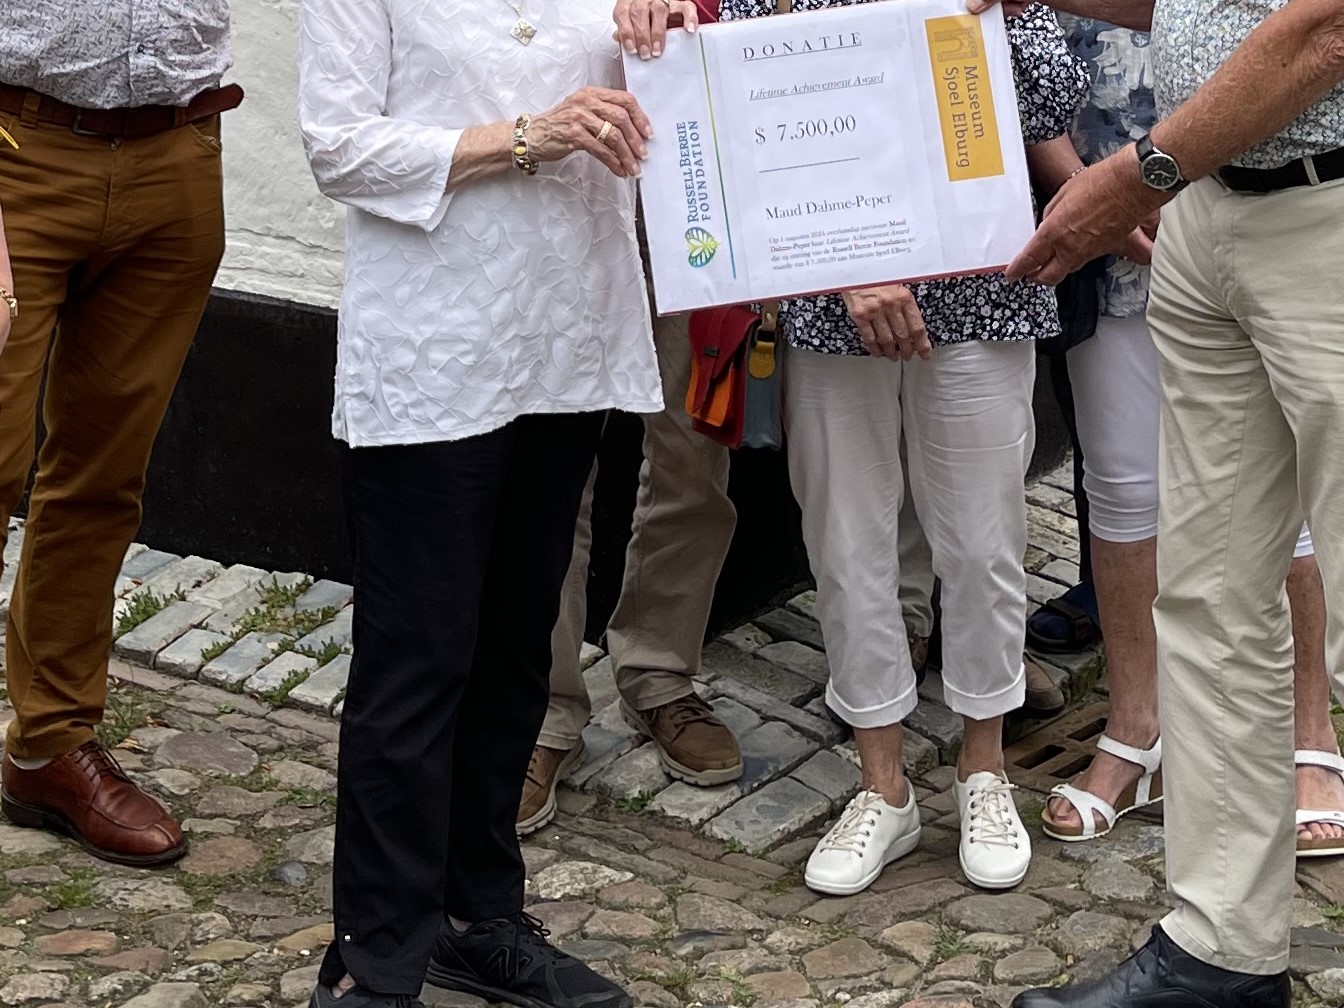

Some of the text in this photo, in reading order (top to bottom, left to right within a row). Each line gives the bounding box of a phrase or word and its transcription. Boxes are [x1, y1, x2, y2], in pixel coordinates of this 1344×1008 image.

[750, 72, 885, 101] Lifetime Achievement Award
[943, 66, 970, 169] Sjoel Elburg
[963, 65, 985, 139] Museum
[754, 114, 856, 145] $ 7.500,00
[676, 121, 699, 223] RUSSELL BERRIE
[688, 120, 711, 221] FOUNDATION
[765, 194, 893, 220] Maud Dahme-Peper
